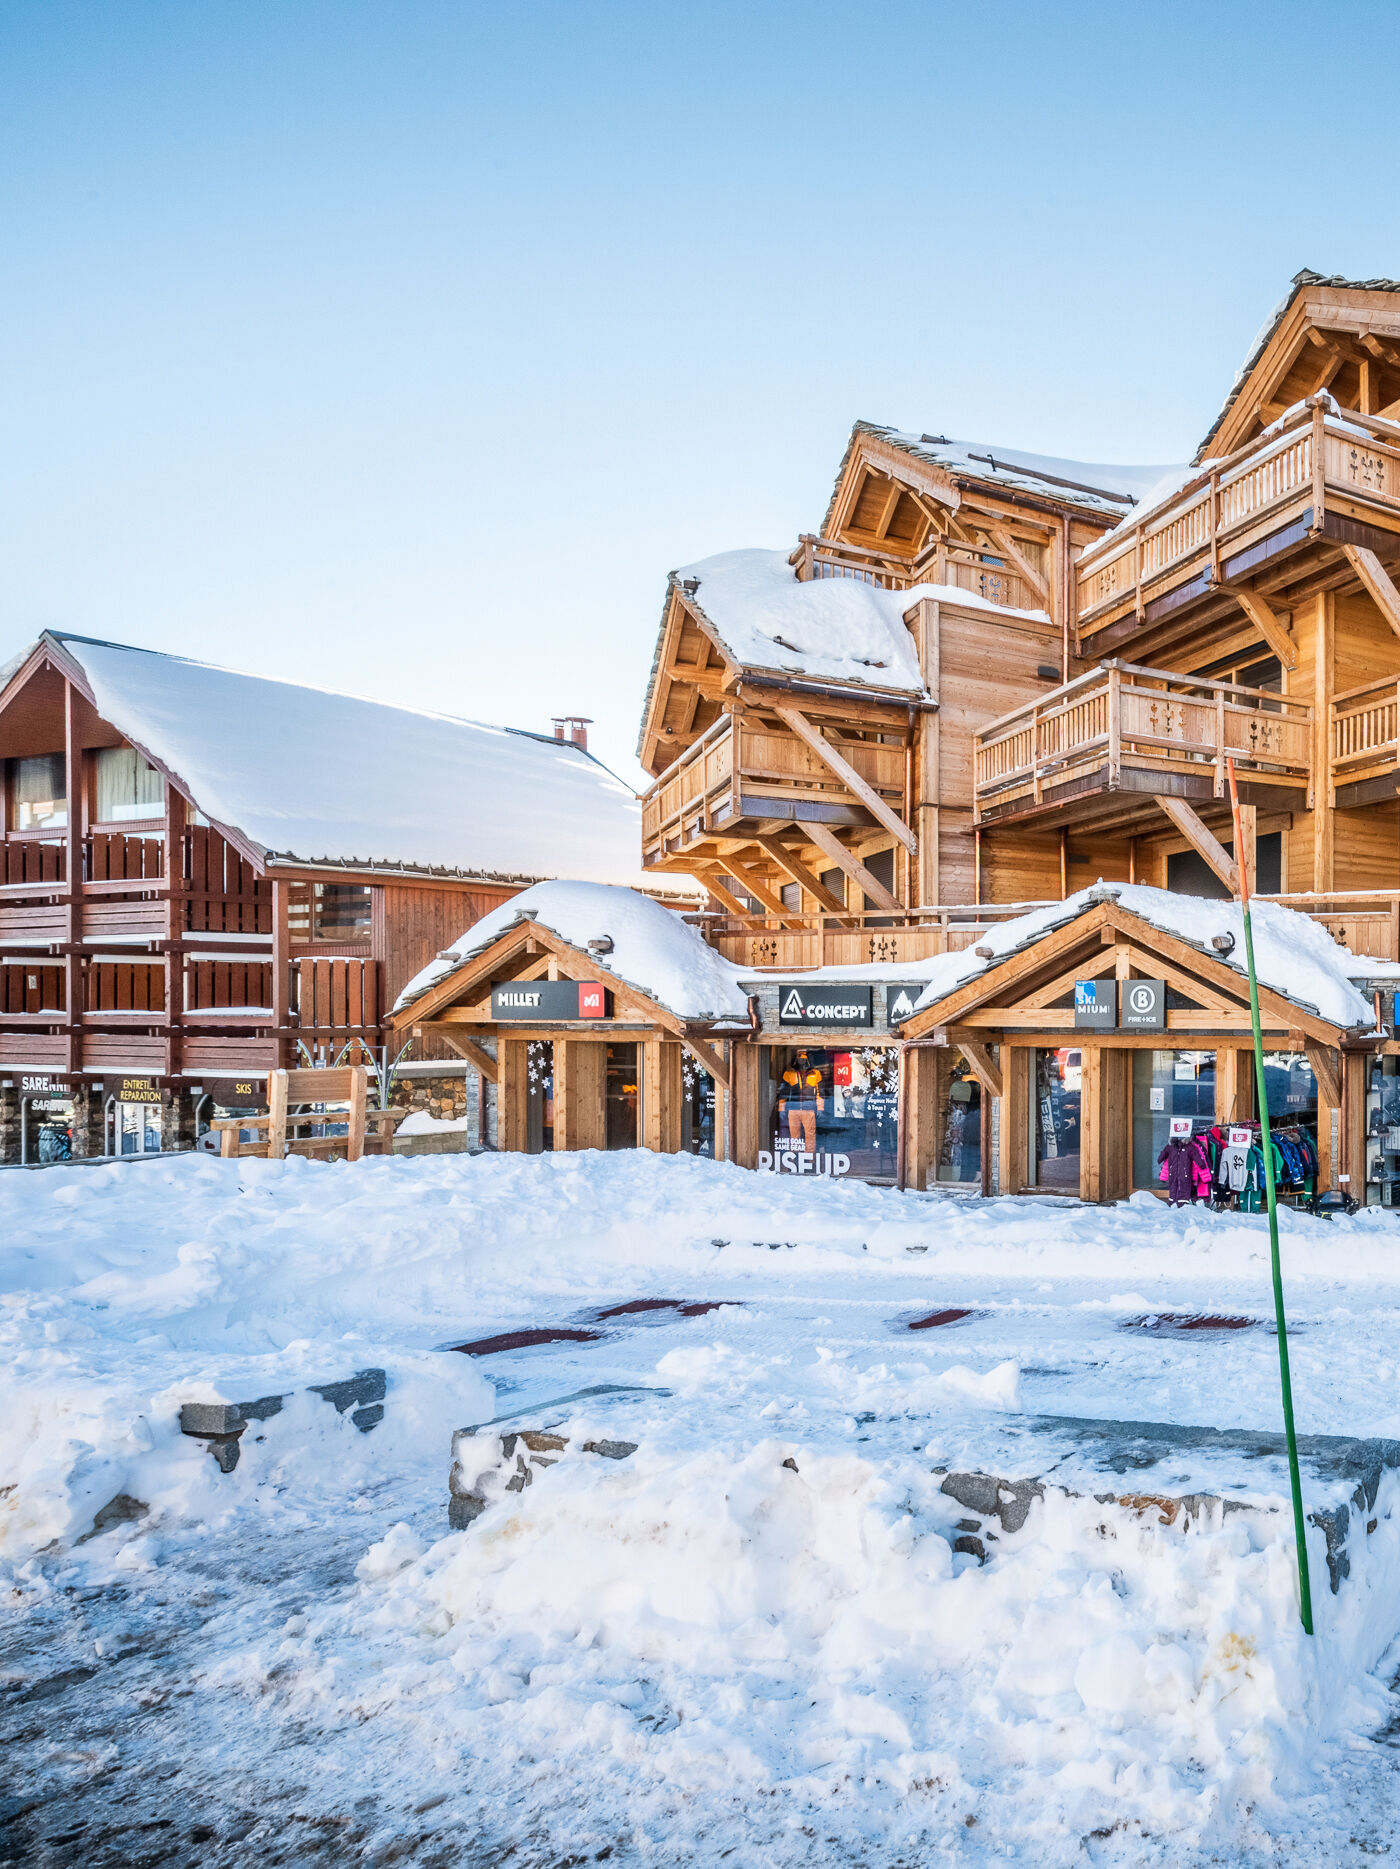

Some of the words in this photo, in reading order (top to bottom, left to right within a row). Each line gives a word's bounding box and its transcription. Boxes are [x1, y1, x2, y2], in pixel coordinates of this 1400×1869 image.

[497, 992, 540, 1007] MILLET
[1077, 995, 1096, 1005] SKI
[806, 1004, 867, 1019] CONCEPT
[1077, 1004, 1107, 1014] MIUM
[235, 1083, 252, 1094] SKIS
[120, 1090, 162, 1102] REPARATION
[774, 1143, 790, 1151] SAME
